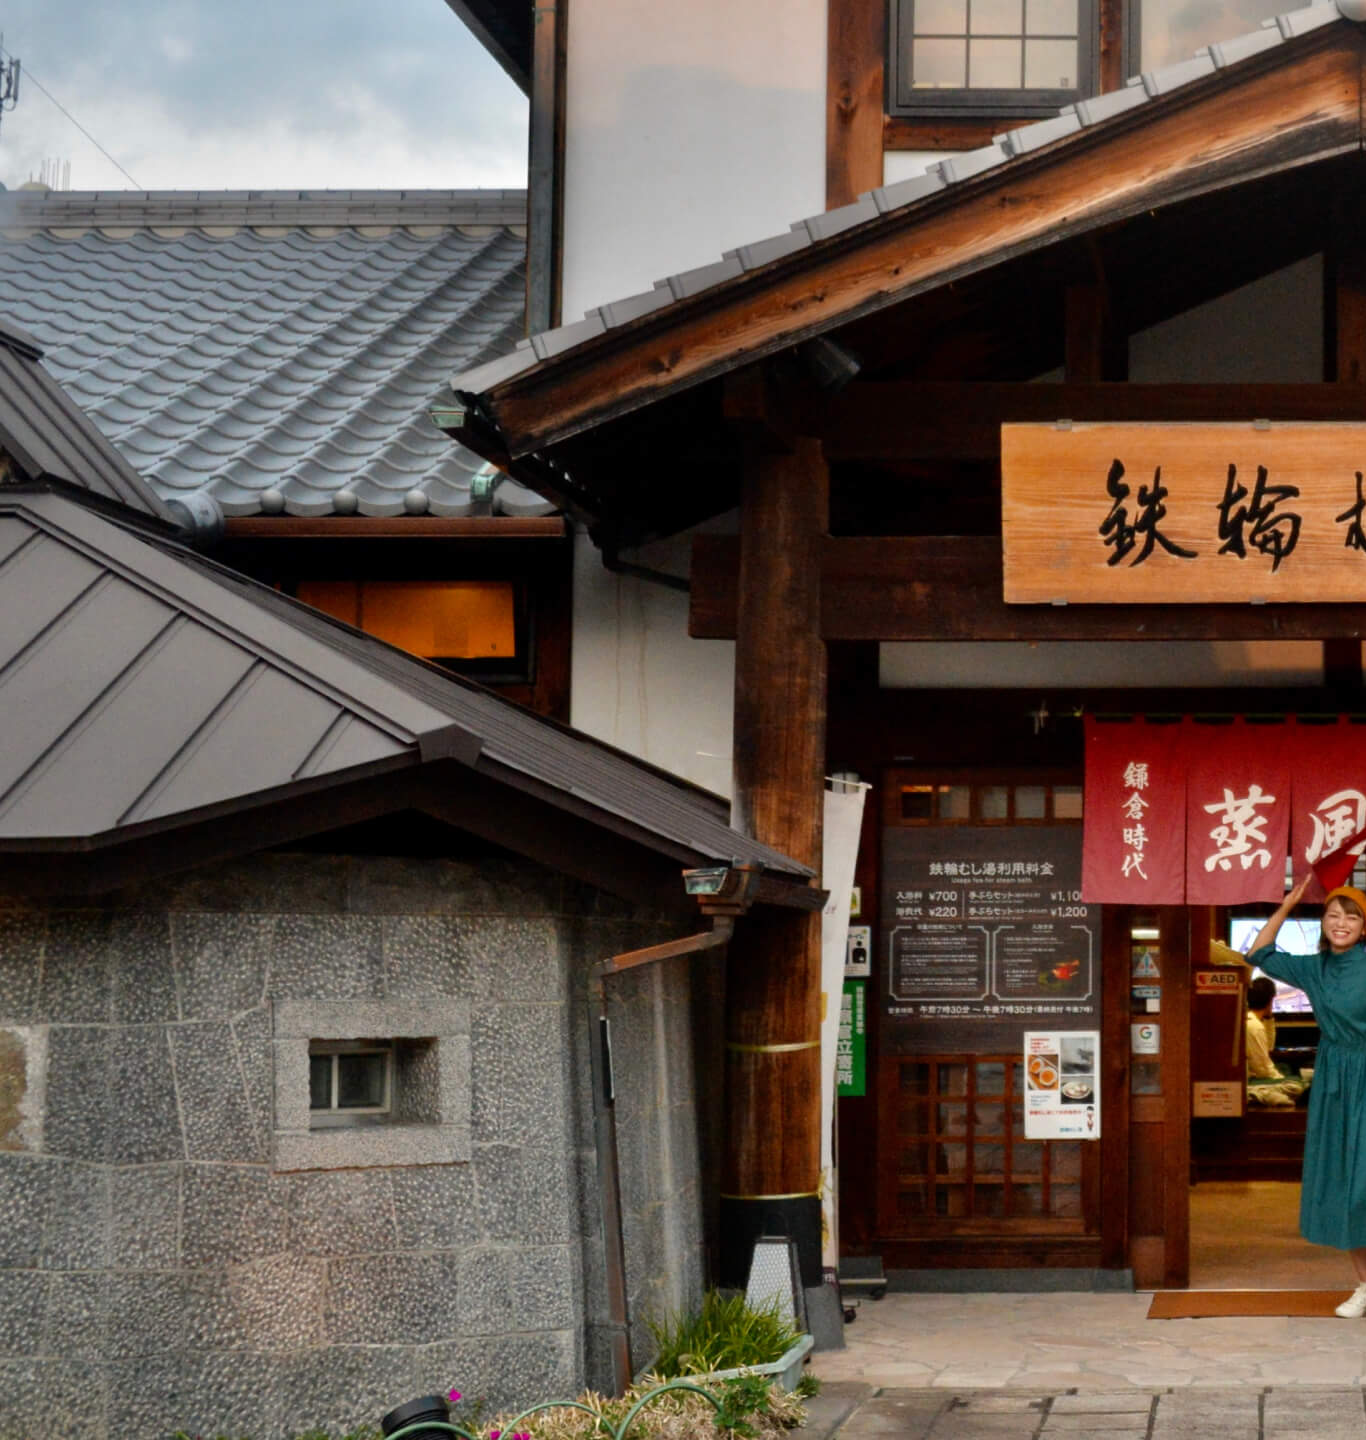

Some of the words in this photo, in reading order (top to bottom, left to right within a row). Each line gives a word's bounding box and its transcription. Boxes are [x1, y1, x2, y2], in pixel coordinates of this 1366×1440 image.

[1121, 762, 1149, 881] 鎌倉時代
[928, 861, 1055, 876] 鉄輪むし湯利用料金
[928, 891, 958, 902] ¥700
[928, 907, 958, 917] ¥220
[1050, 906, 1088, 918] ¥1,200
[1210, 974, 1236, 984] AED
